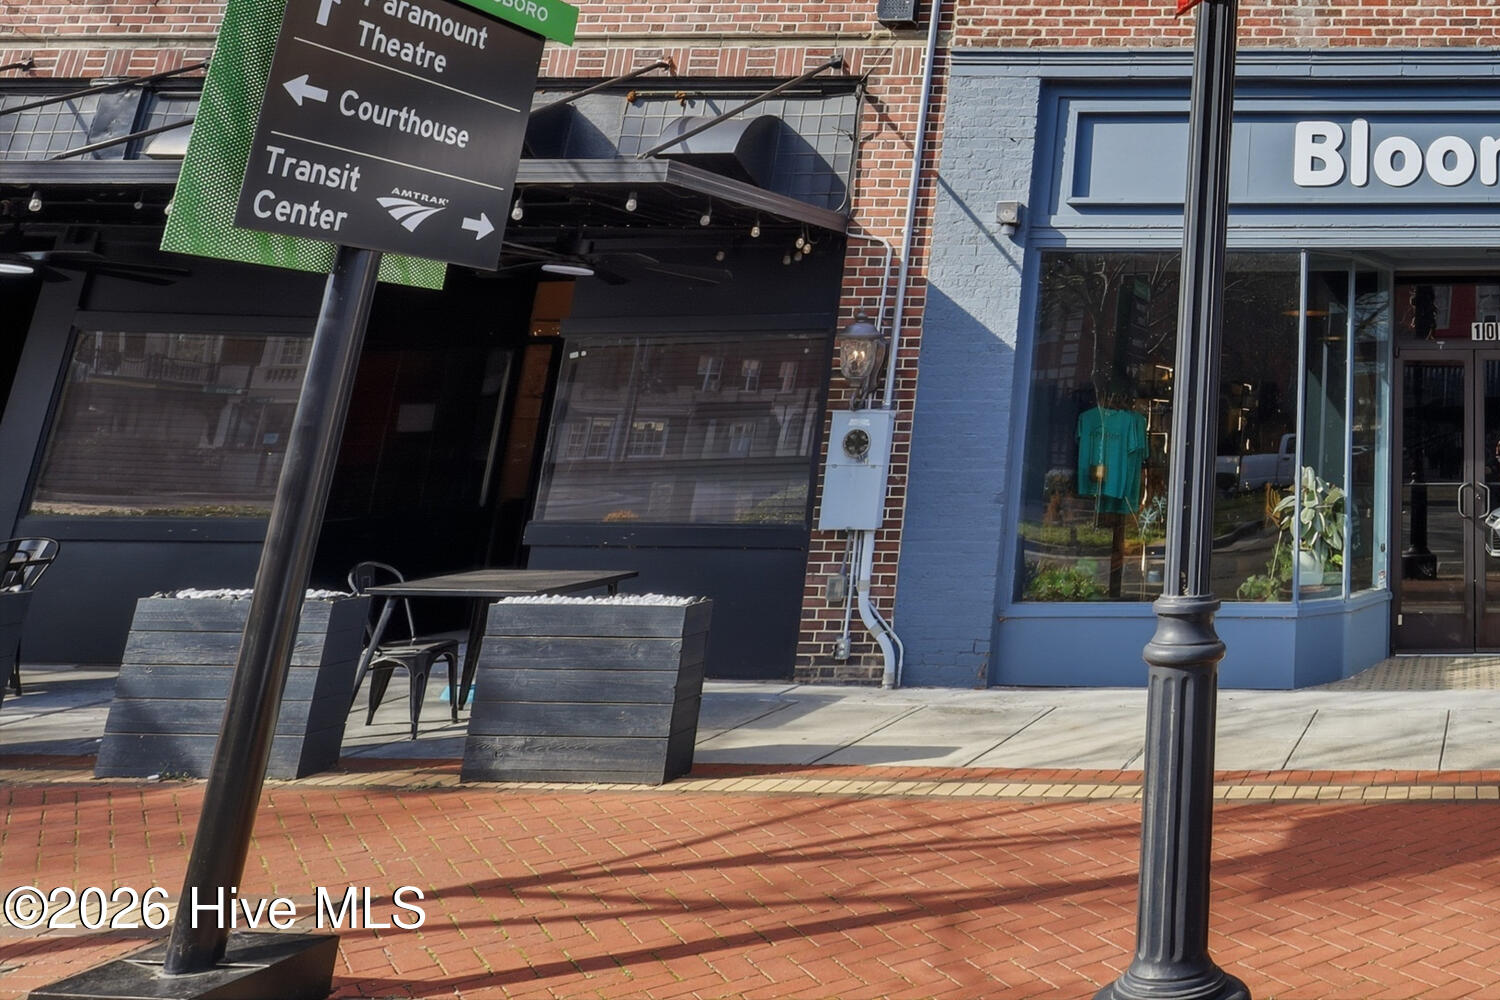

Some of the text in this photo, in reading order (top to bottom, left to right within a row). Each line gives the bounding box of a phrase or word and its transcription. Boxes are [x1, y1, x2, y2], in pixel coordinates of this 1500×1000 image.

[358, 20, 448, 74] Theatre
[339, 89, 470, 149] Courthouse
[265, 145, 361, 193] Transit
[253, 189, 348, 232] Center
[391, 187, 448, 206] AMTRAK
